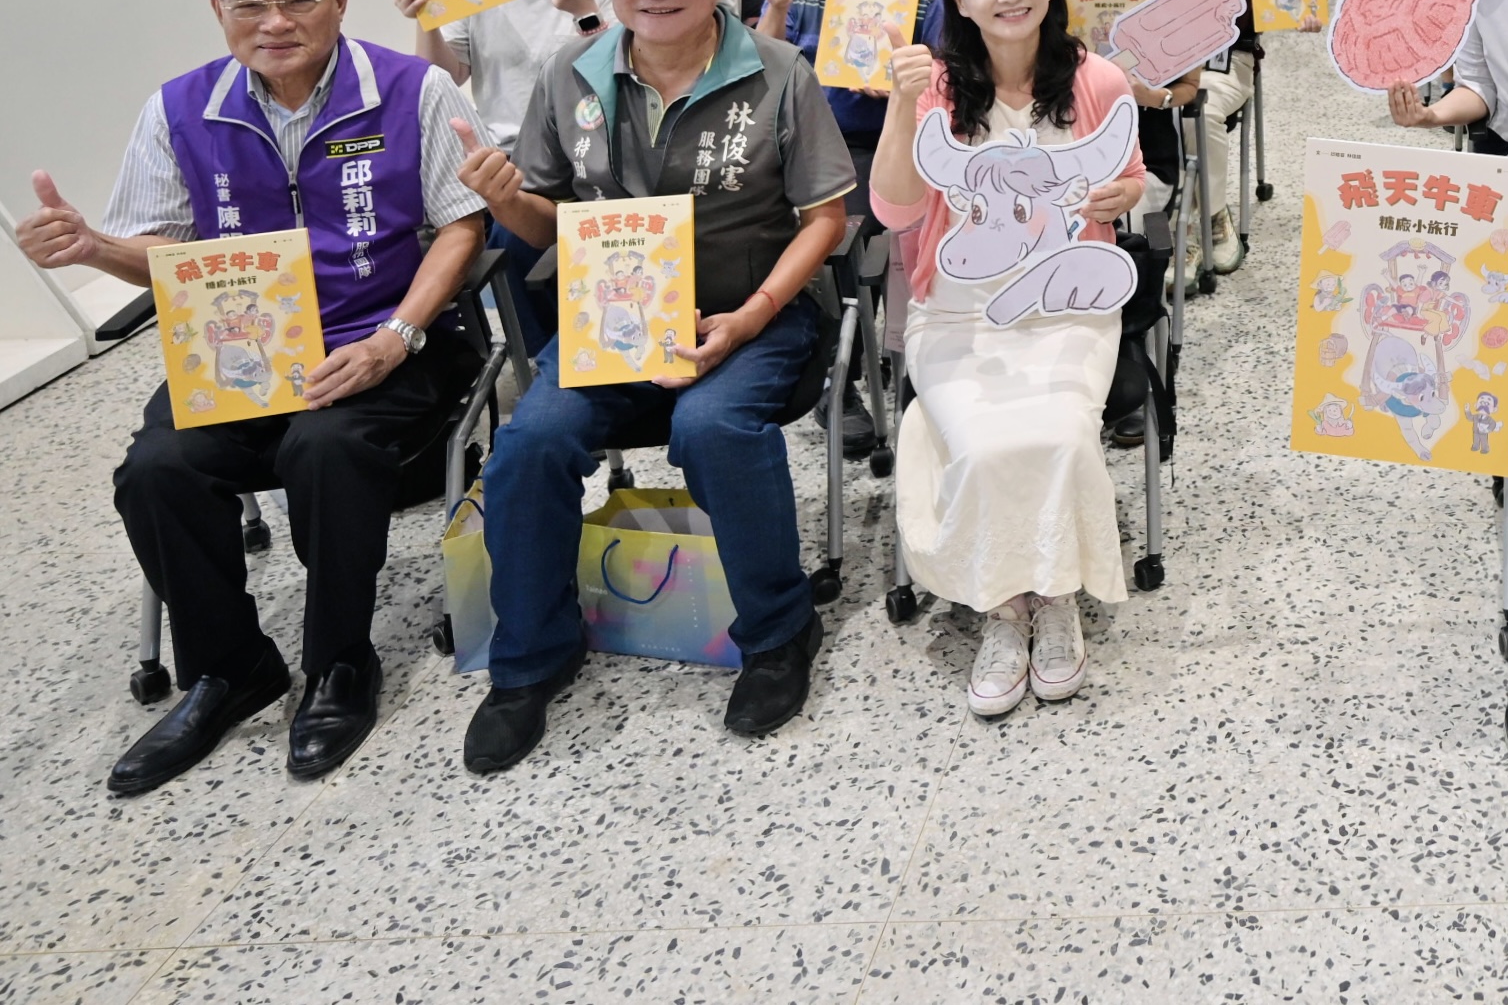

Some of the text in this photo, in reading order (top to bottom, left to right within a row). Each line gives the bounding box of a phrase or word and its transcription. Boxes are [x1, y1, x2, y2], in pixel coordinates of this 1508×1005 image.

[345, 139, 381, 152] DPP
[573, 136, 591, 180] 特助
[717, 100, 757, 192] 林俊憲
[214, 173, 231, 203] 秘書
[340, 159, 377, 237] 邱莉莉
[1337, 168, 1504, 224] 飛天牛車
[577, 213, 668, 241] 飛天牛車
[1379, 215, 1459, 237] 糖廠小旅行
[175, 251, 281, 284] 飛天牛車
